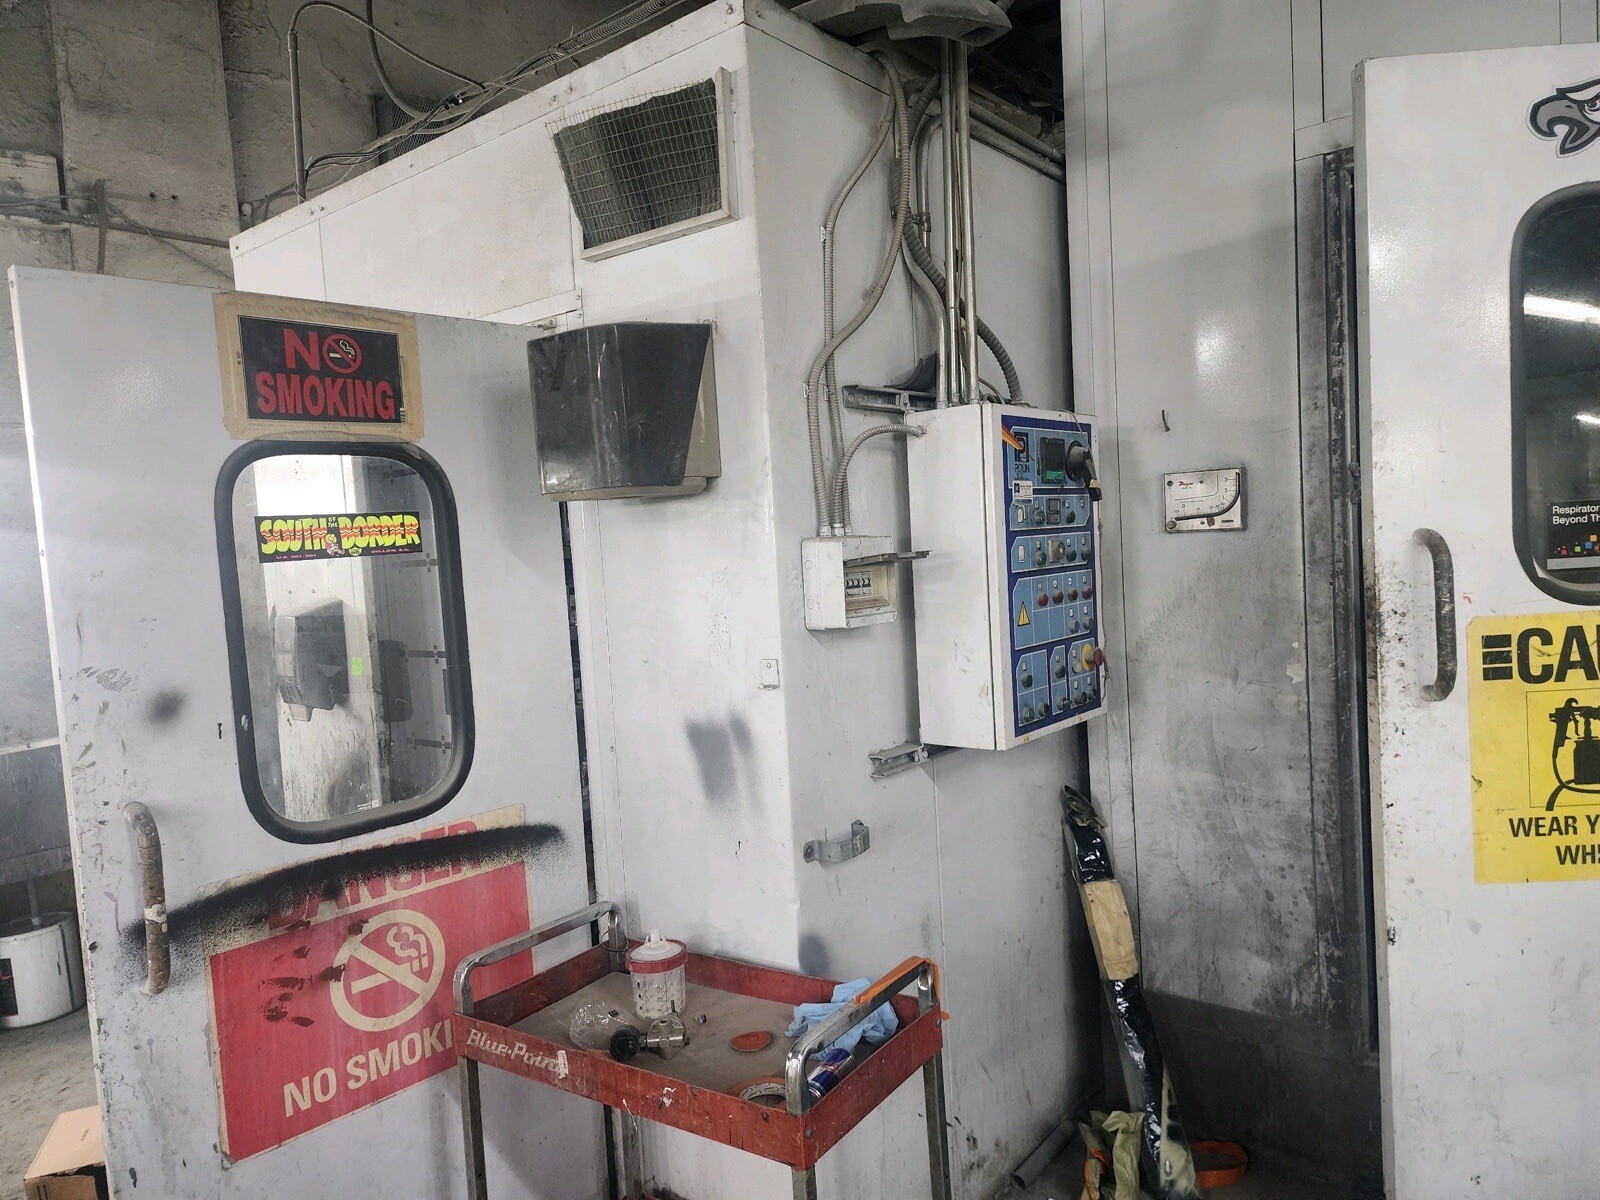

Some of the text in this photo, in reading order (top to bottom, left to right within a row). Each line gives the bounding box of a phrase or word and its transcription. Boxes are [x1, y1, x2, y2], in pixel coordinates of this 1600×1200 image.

[255, 371, 395, 420] SMOKING
[260, 517, 328, 554] SOUTH
[338, 514, 420, 550] BORDER
[1552, 514, 1588, 526] Beyond
[1508, 815, 1578, 838] WEAR
[1555, 844, 1600, 866] WH
[283, 1018, 453, 1118] NO SMOKI
